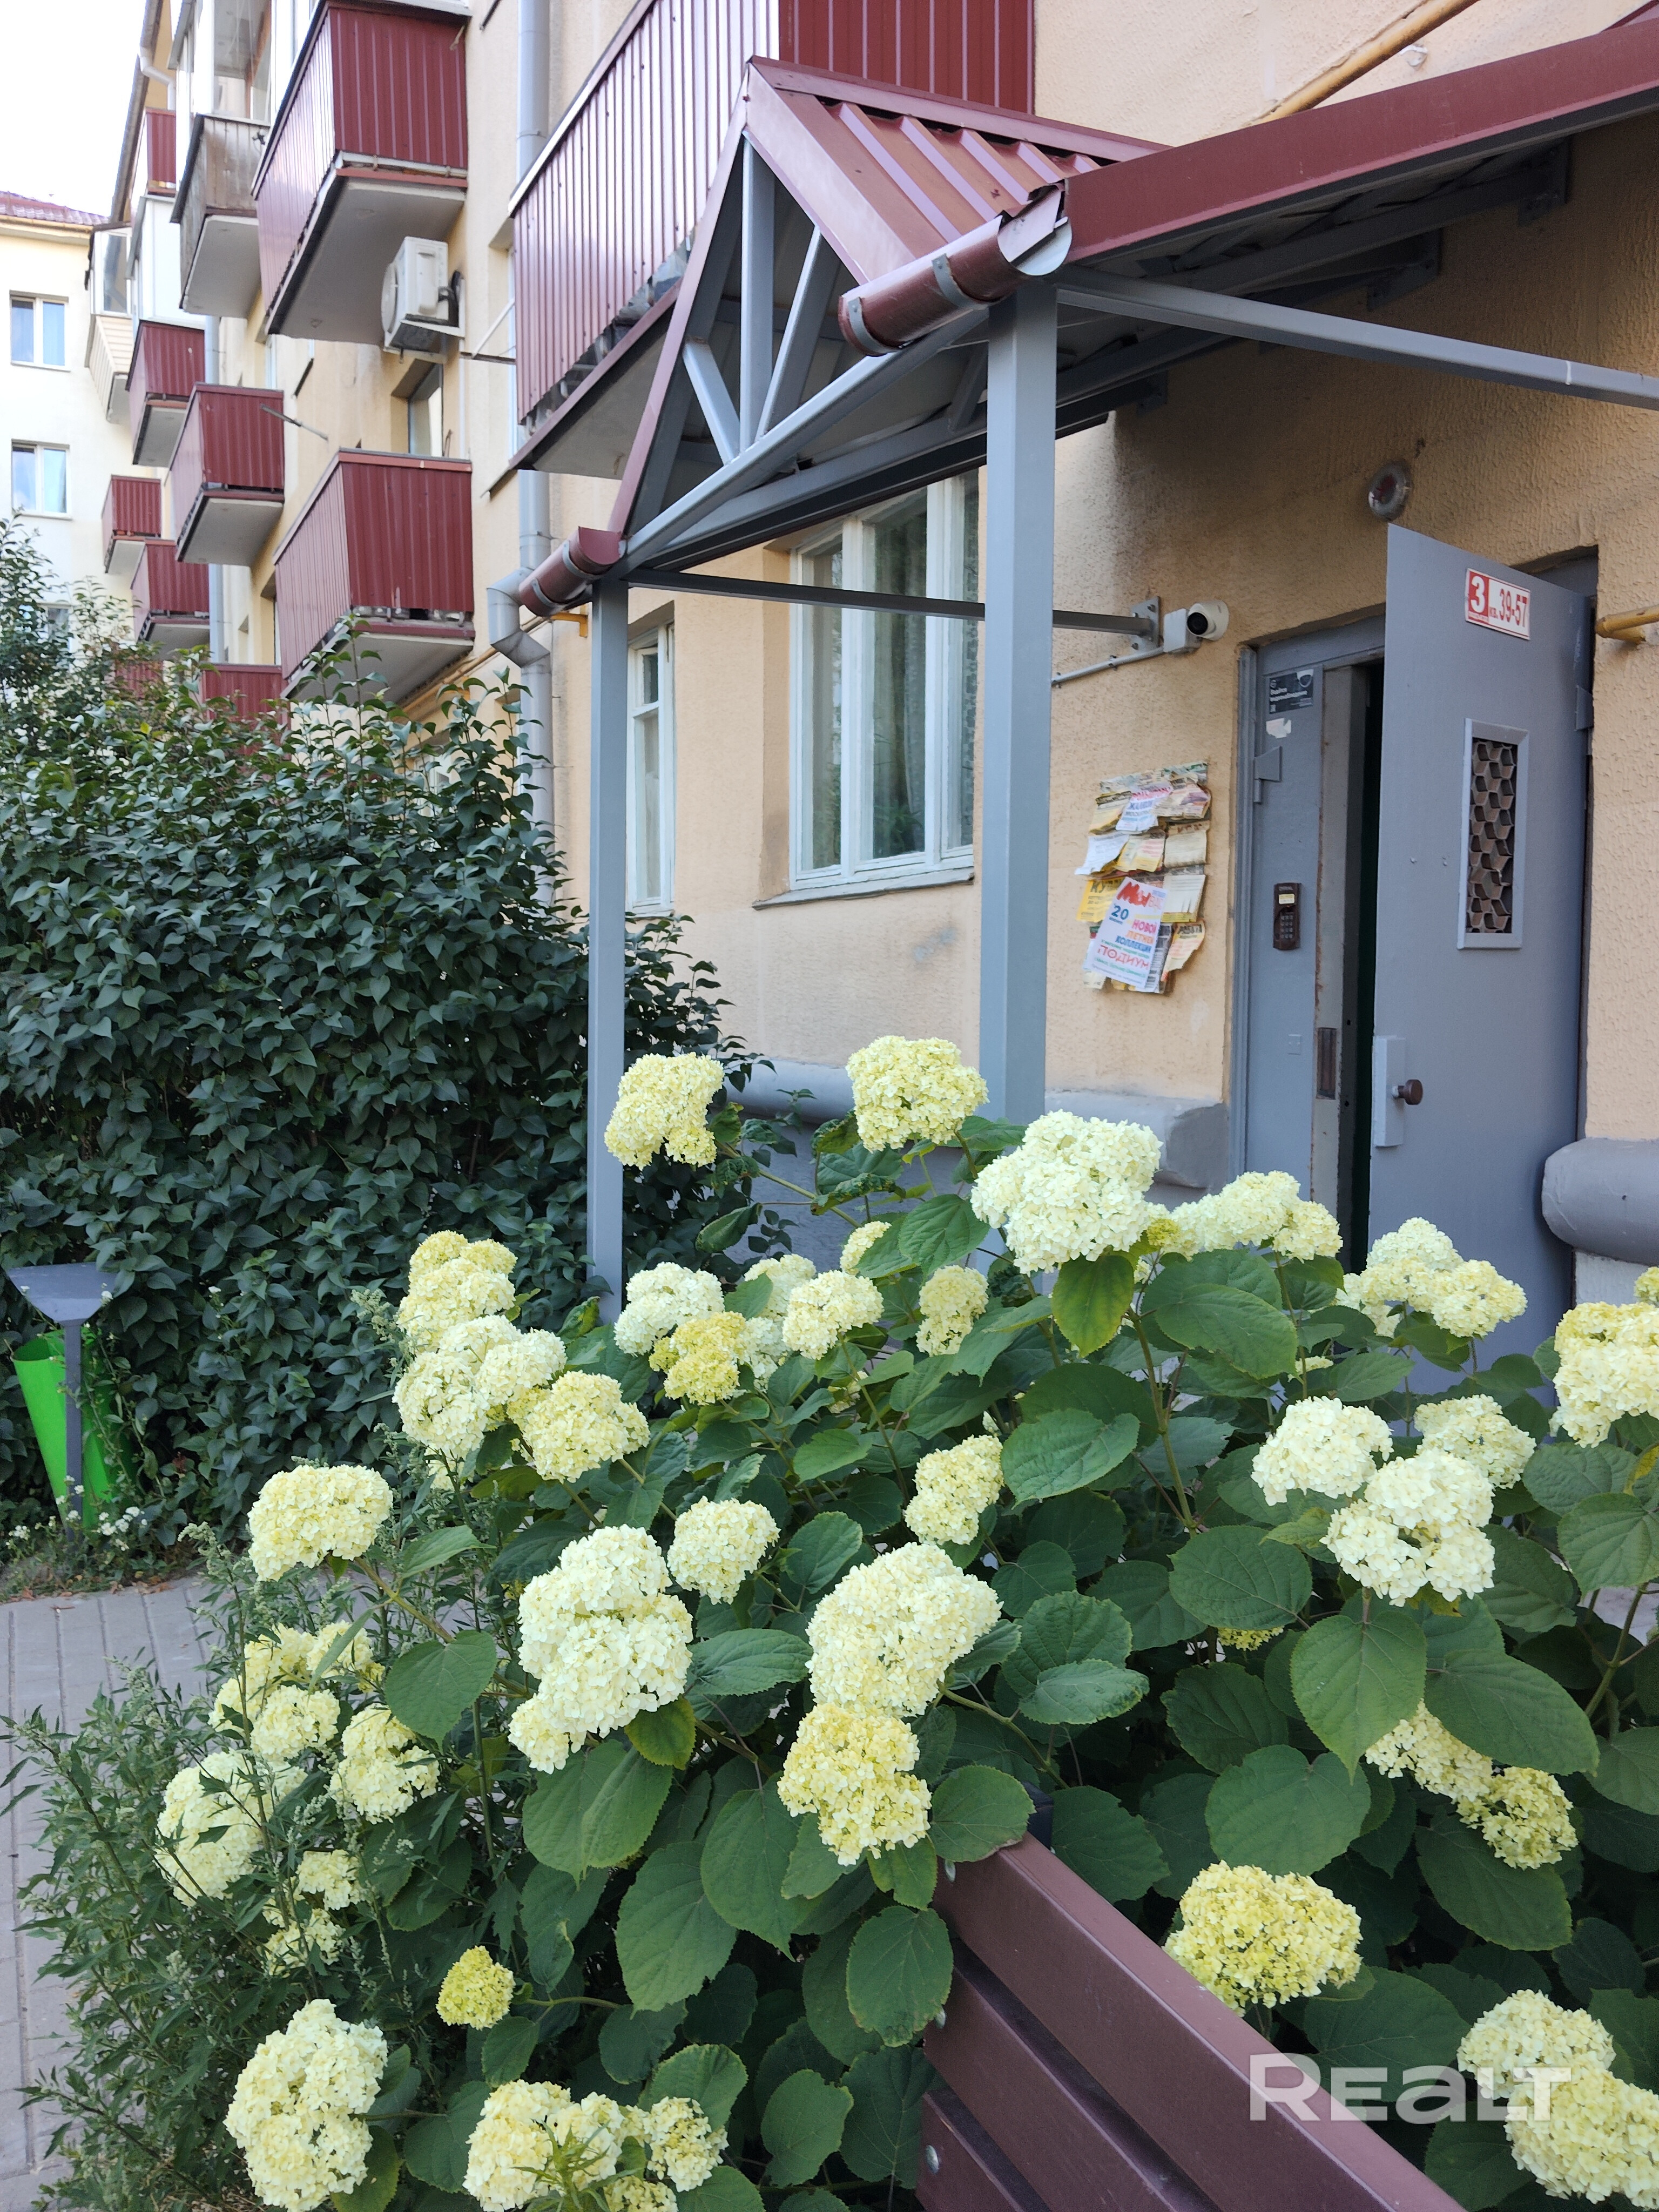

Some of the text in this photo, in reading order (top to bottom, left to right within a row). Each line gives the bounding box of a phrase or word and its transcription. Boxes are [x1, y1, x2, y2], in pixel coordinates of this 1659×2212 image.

[1471, 576, 1485, 613] 3
[1500, 589, 1528, 628] 39-57
[1111, 904, 1129, 920] 20
[1097, 945, 1150, 970] ПОДИУМ
